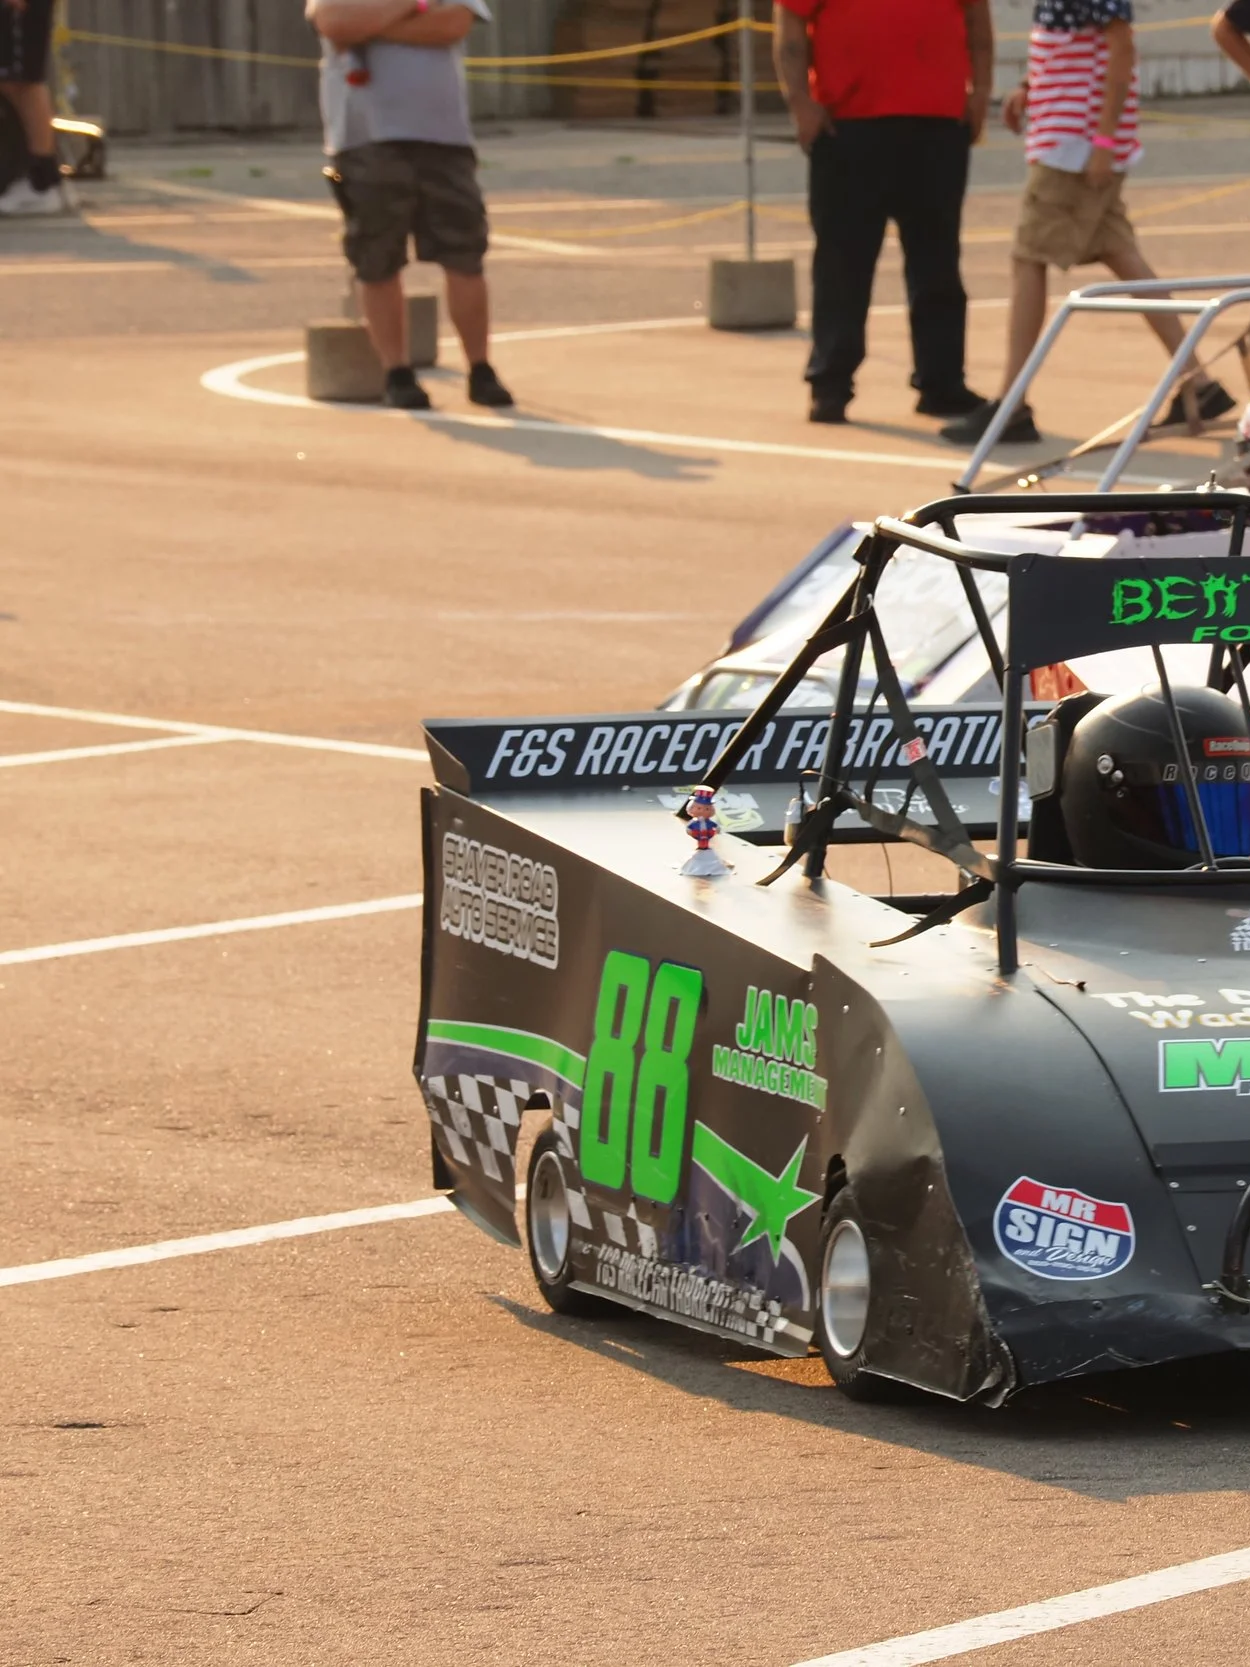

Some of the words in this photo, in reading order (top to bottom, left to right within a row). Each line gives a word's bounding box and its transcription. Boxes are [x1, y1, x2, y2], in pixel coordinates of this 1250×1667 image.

[485, 728, 575, 778] F&S
[1089, 990, 1206, 1008] The
[736, 985, 819, 1069] JAMS
[580, 950, 703, 1204] 88
[1040, 1189, 1098, 1222] MR
[1004, 1208, 1121, 1258] SIGN
[1044, 1246, 1117, 1267] Design
